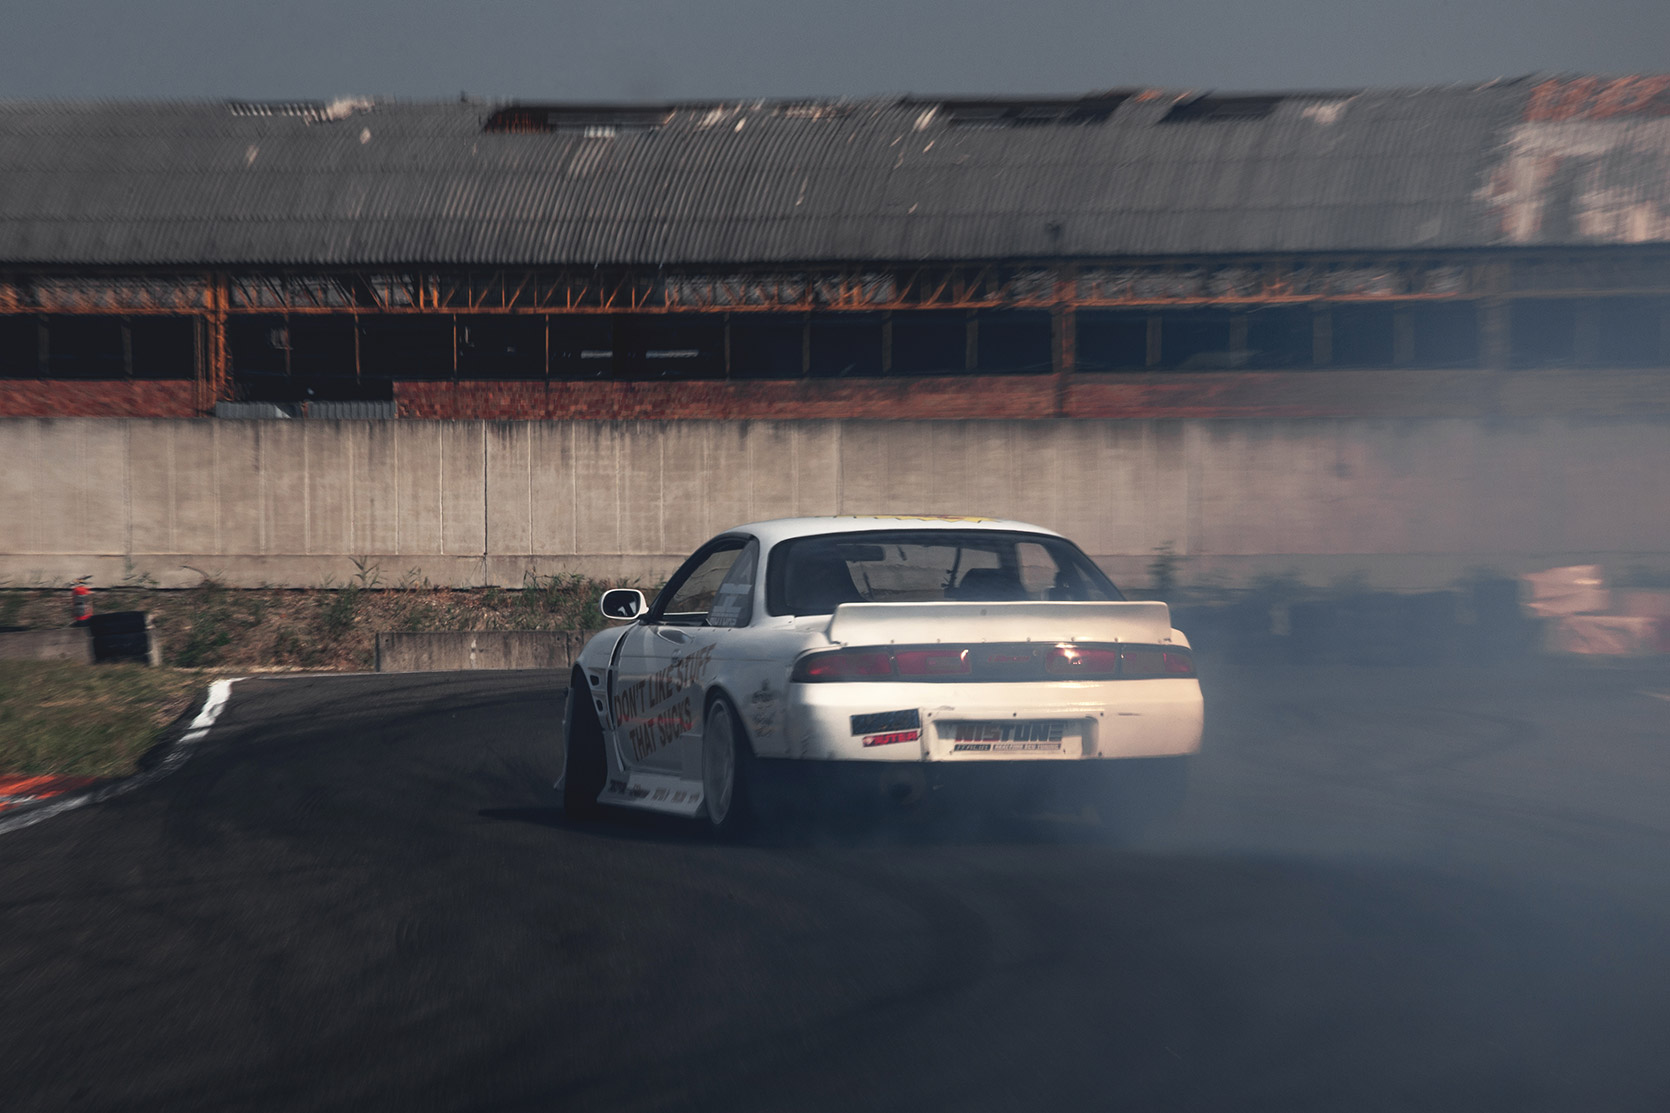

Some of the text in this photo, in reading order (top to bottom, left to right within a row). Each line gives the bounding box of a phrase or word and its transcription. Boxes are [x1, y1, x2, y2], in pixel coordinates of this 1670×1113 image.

[614, 679, 646, 727] DON'T
[649, 664, 673, 709] LIKE
[675, 642, 717, 693] STUFF
[629, 718, 657, 761] THAT
[657, 696, 693, 747] SUCKS
[954, 724, 1065, 742] NISTUNE
